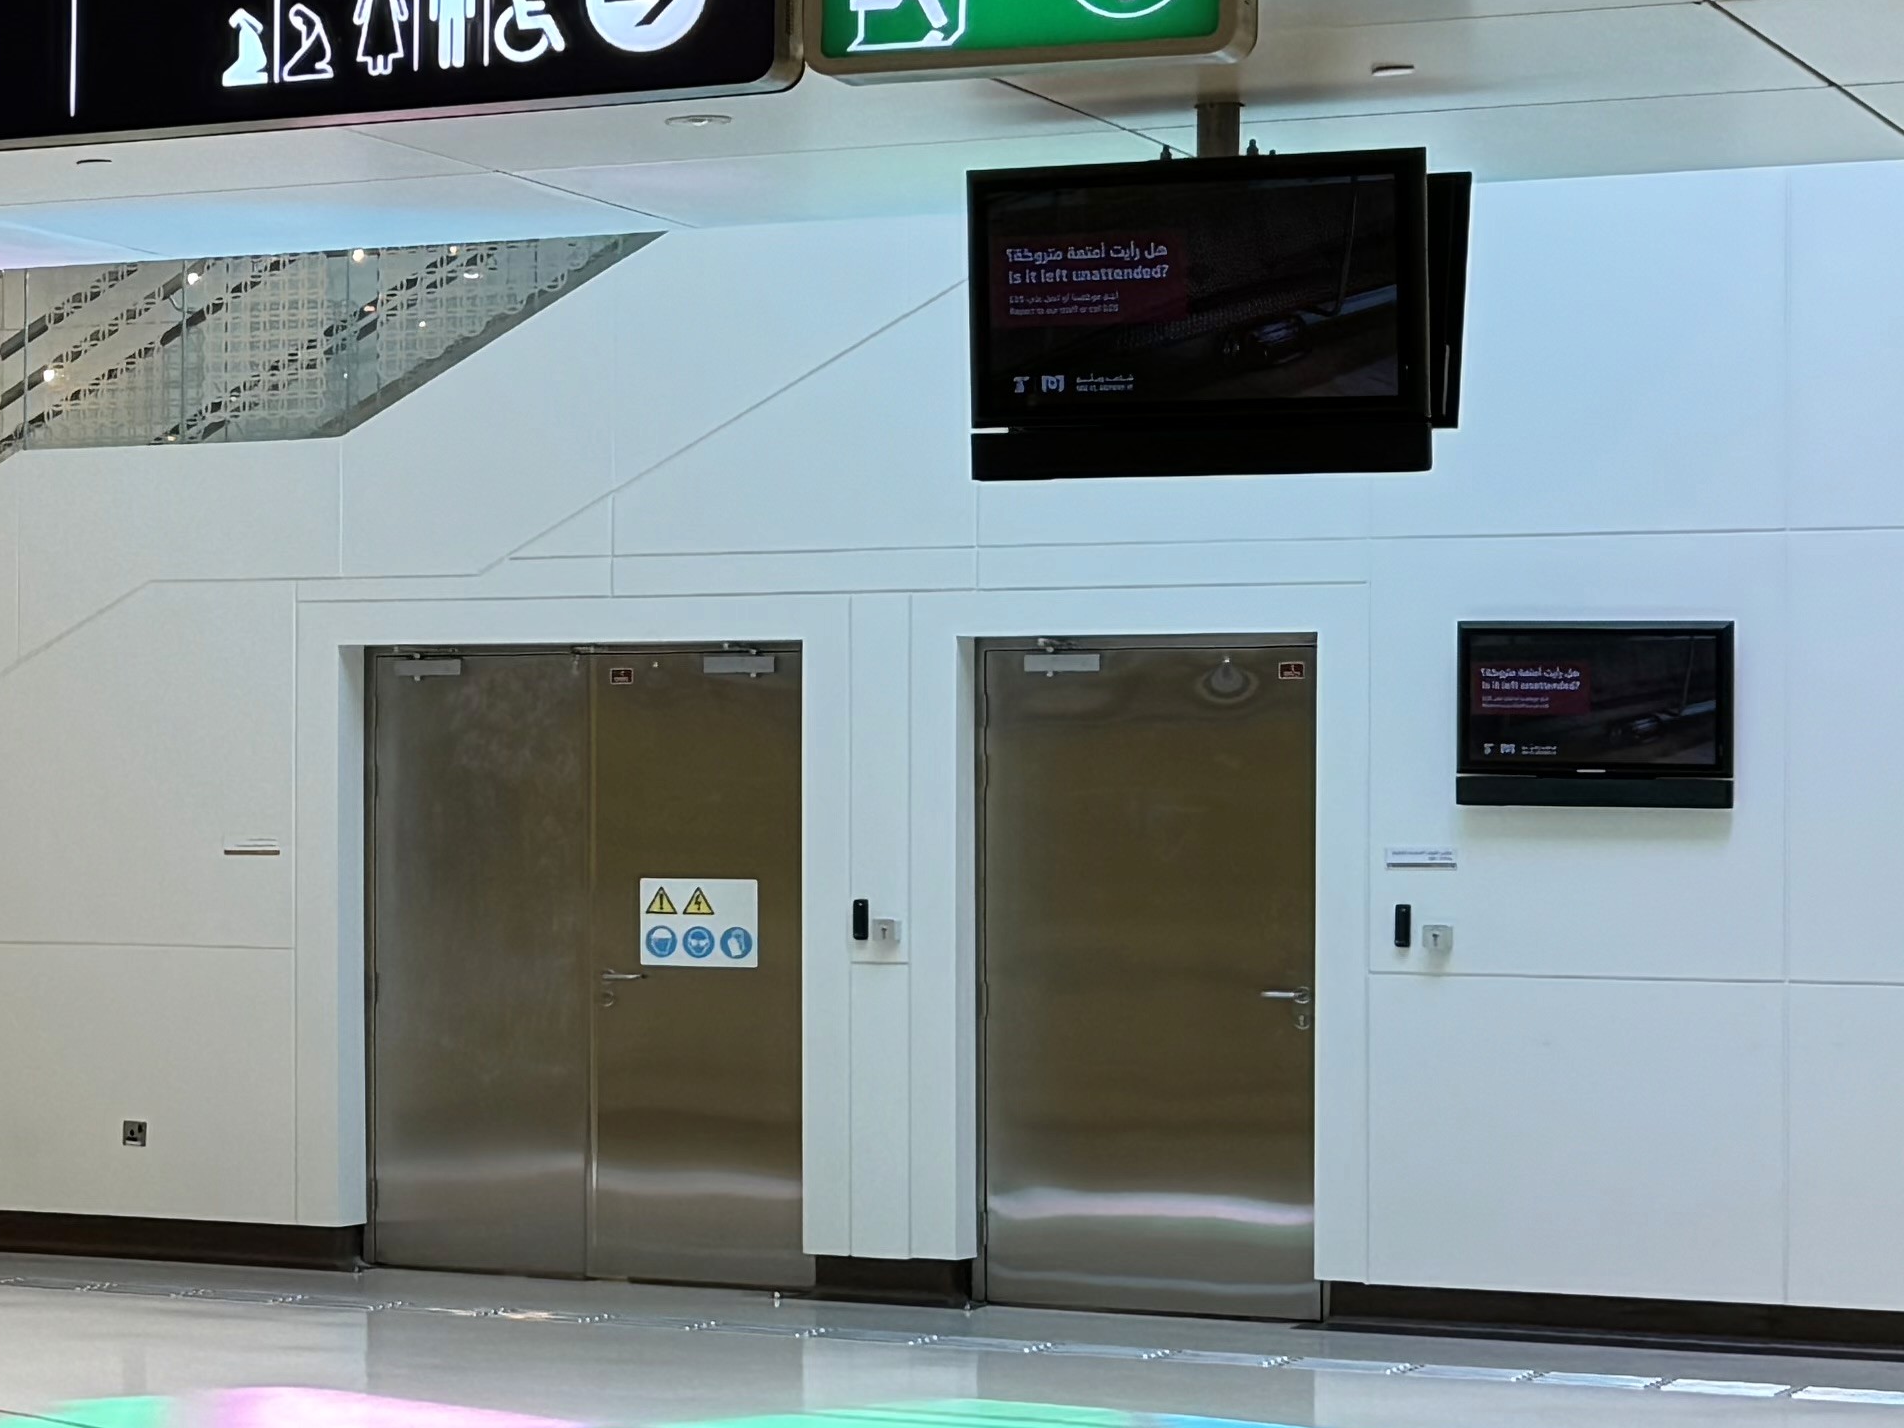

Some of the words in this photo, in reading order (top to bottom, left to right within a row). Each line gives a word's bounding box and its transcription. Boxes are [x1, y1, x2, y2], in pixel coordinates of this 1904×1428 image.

[1009, 271, 1021, 284] Is
[1026, 269, 1036, 283] it
[1041, 269, 1067, 282] left
[1073, 265, 1169, 281] unattended?
